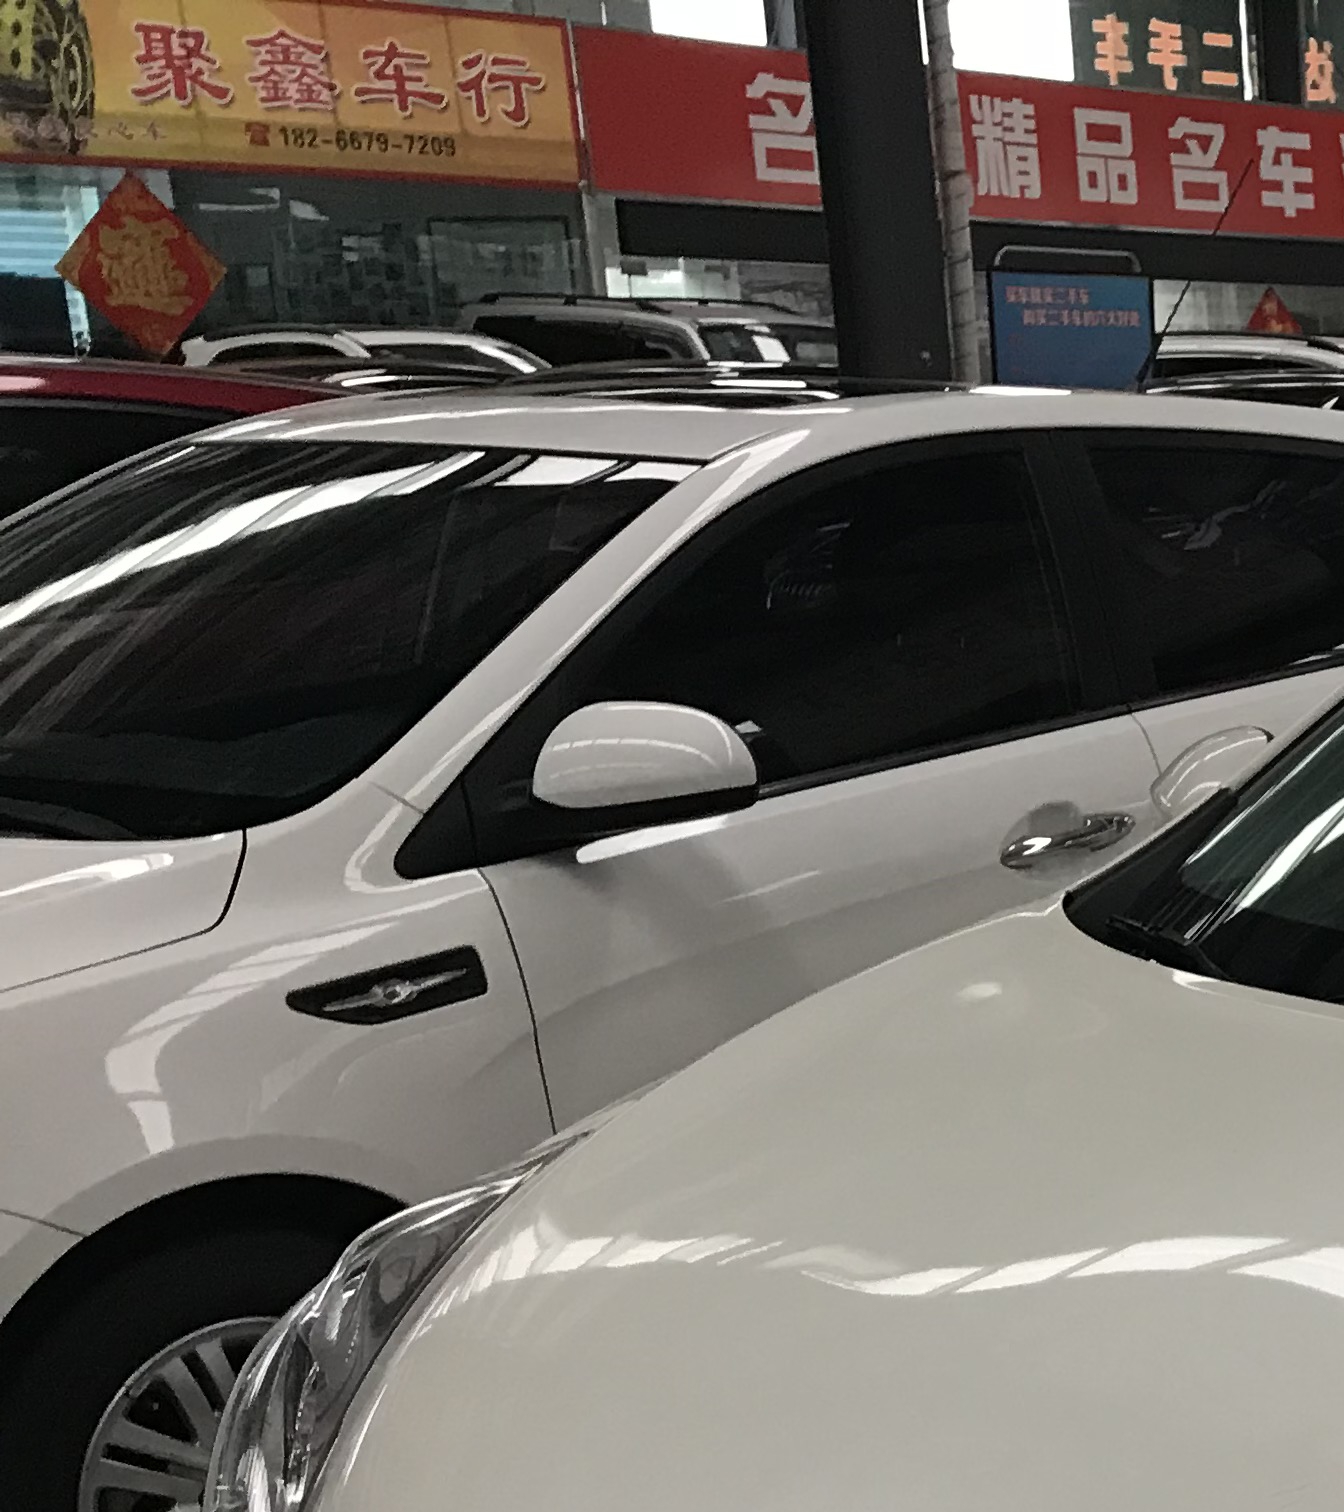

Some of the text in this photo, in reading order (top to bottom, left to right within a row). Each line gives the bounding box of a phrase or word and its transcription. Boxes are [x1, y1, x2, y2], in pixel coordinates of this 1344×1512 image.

[130, 20, 548, 128] 聚鑫车行
[278, 126, 457, 158] 182-6679-7209
